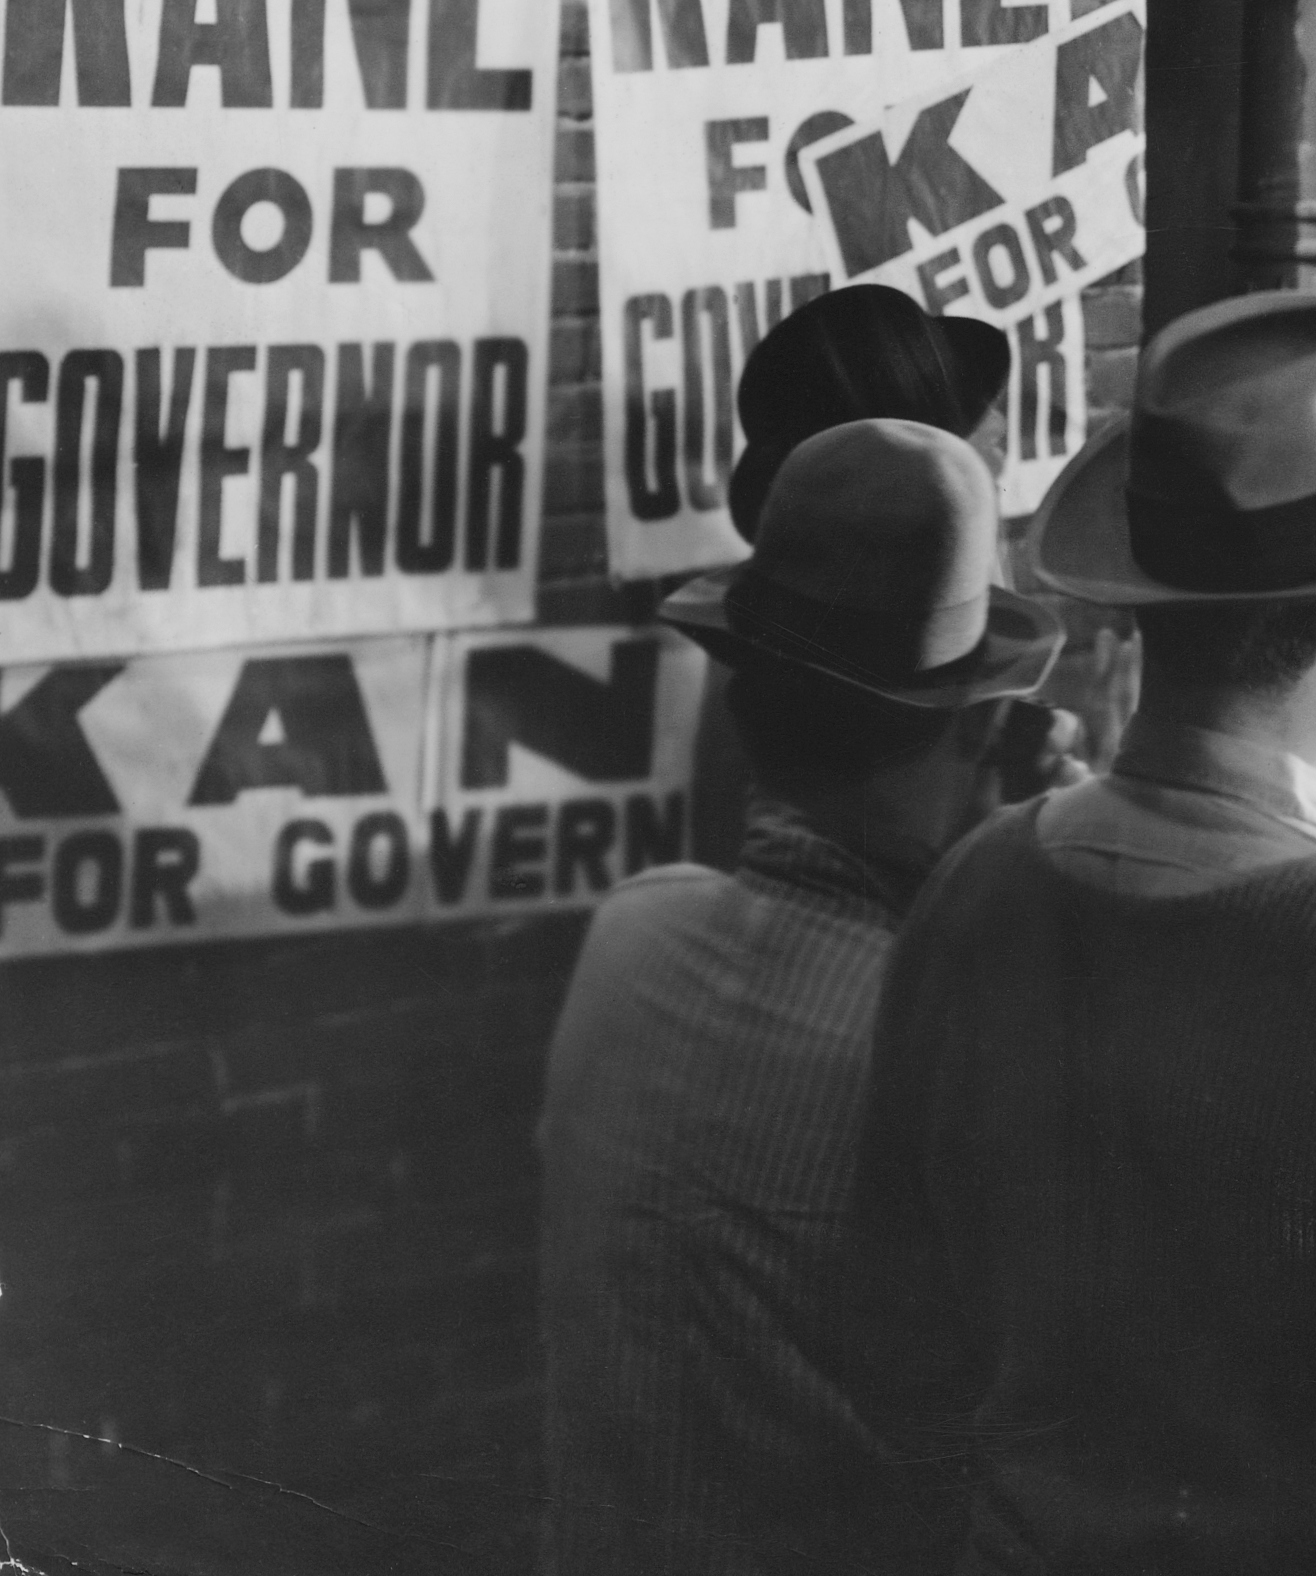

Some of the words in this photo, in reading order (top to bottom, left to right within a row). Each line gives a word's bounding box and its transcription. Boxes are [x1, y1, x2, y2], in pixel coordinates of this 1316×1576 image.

[815, 11, 1144, 279] KA
[109, 167, 436, 287] FOR
[915, 195, 1088, 316] FOR
[0, 337, 529, 602] GOVERNOR
[0, 637, 661, 819] KAN
[272, 790, 686, 915] GOVERN
